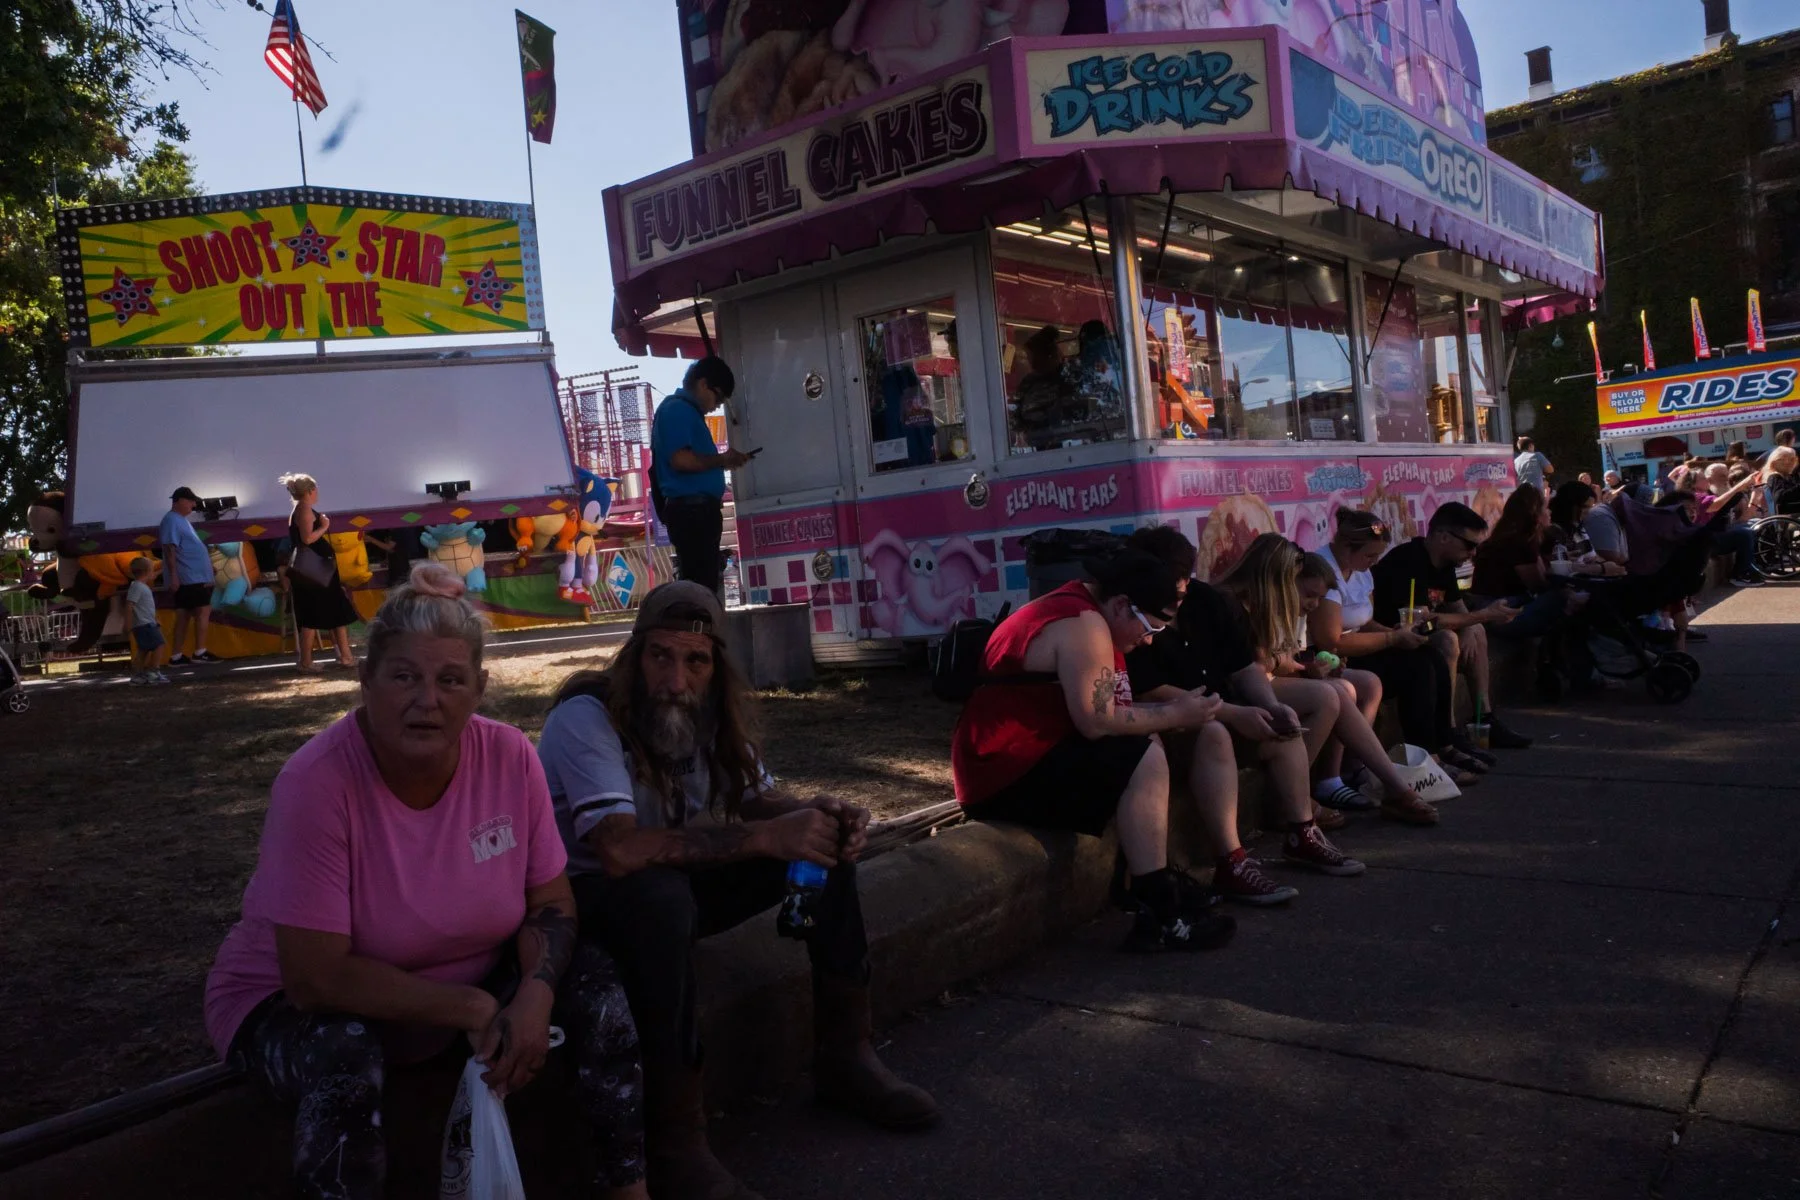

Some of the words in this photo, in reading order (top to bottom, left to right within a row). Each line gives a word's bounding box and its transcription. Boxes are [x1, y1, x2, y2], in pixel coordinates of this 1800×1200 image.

[1069, 55, 1129, 88] ICE
[1130, 49, 1234, 87] COLD
[1045, 73, 1257, 138] DRINKS
[1335, 90, 1419, 149] DEEP
[1328, 108, 1422, 181] FRIED
[632, 148, 802, 260] FUNNEL
[806, 81, 988, 201] CAKES
[1419, 136, 1484, 207] OREO
[159, 219, 281, 294] SHOOT
[355, 220, 447, 288] STAR
[239, 282, 307, 332] OUT
[325, 281, 384, 328] THE
[1610, 396, 1646, 408] RELOAD
[1611, 391, 1630, 399] BUY
[1631, 389, 1645, 397] OR
[1616, 404, 1641, 414] HERE
[1659, 367, 1797, 413] RIDES
[1179, 468, 1244, 496] FUNNEL
[1244, 468, 1295, 494] CAKES
[1382, 461, 1431, 486] ELEPHANT
[1434, 463, 1456, 486] EARS
[1487, 463, 1508, 480] OREO
[1005, 479, 1077, 520] ELEPHANT
[1081, 473, 1120, 513] EARS
[754, 520, 796, 549] FUNNEL
[795, 512, 835, 541] CAKES
[470, 826, 518, 864] MOM
